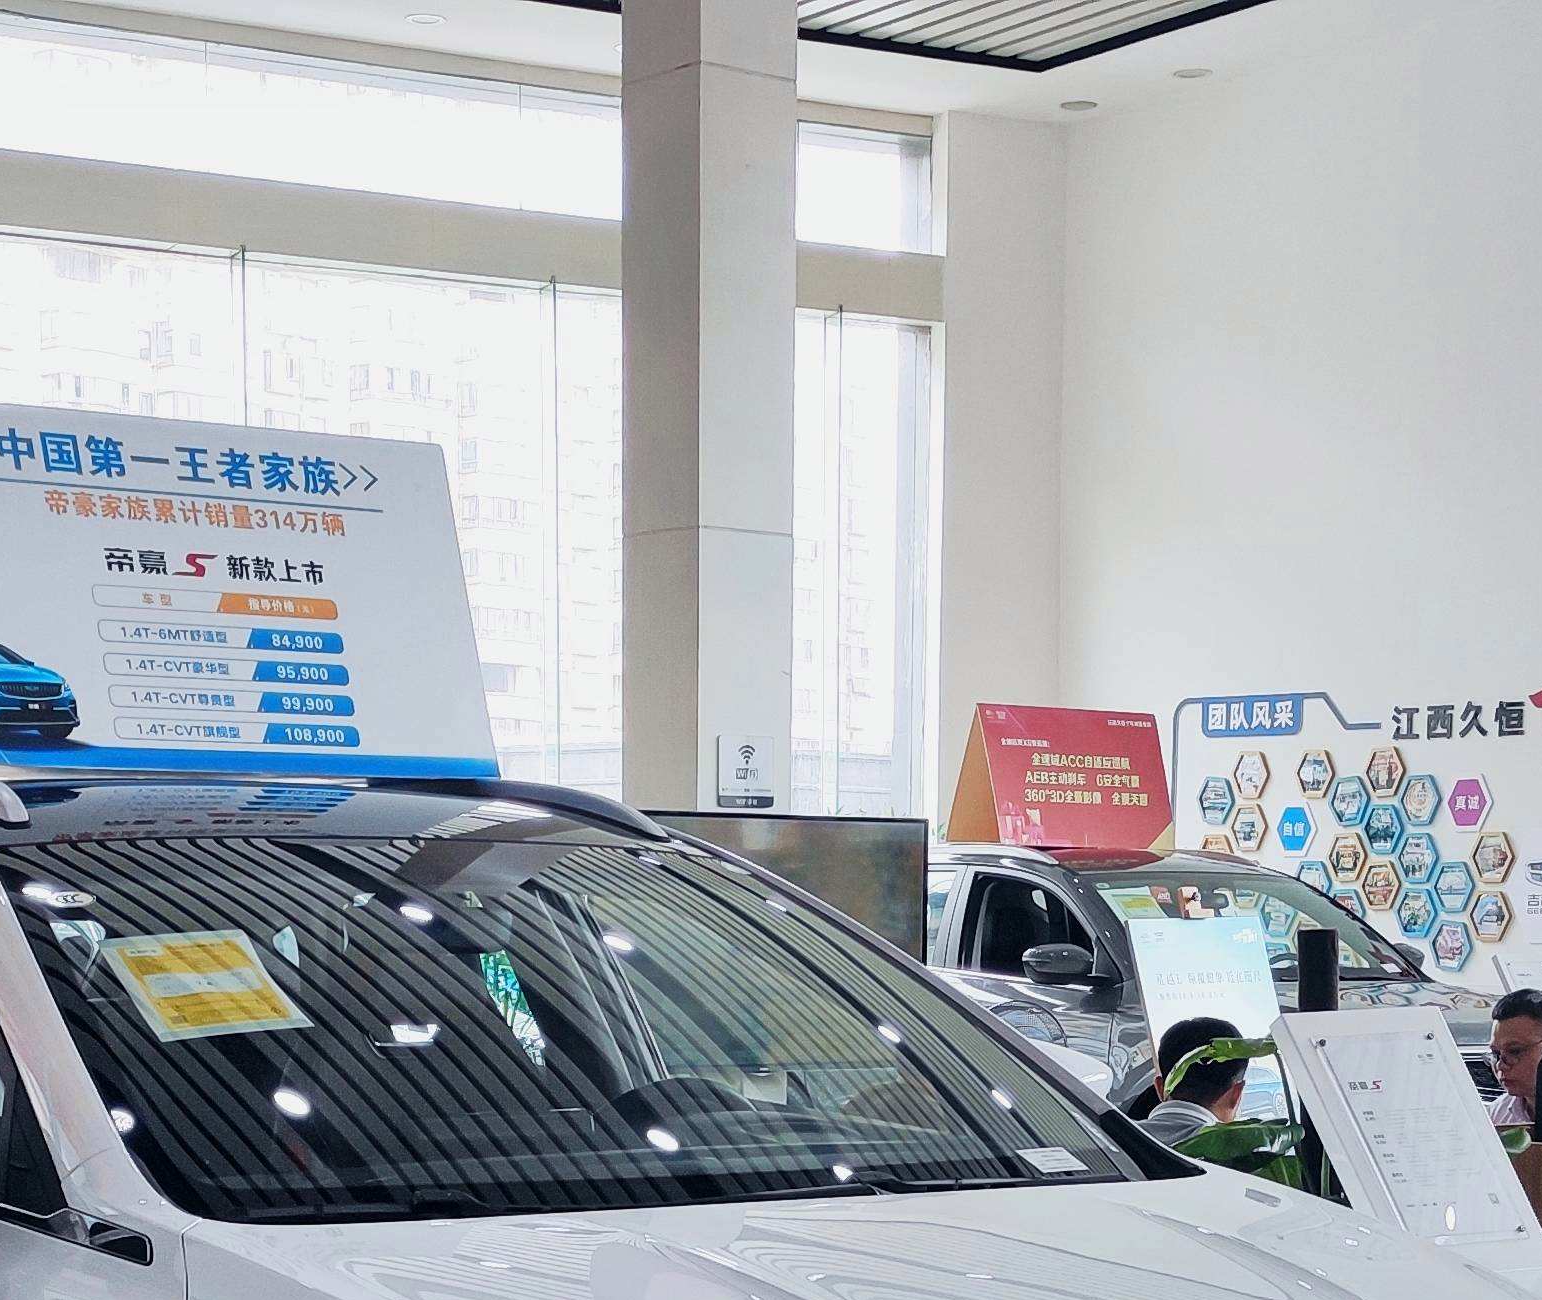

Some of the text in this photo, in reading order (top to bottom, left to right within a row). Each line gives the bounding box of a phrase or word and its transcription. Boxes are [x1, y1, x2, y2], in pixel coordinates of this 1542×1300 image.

[44, 490, 346, 537] 帝豪家族累计销量314万辆
[226, 553, 325, 585] 新款上市
[271, 633, 324, 650] 84,900
[276, 664, 329, 682] 95,900
[281, 696, 334, 713] 99,900
[1206, 700, 1295, 731] 团队风采
[1391, 700, 1526, 740] 江西久恒
[284, 727, 345, 744] 108,900
[1454, 793, 1481, 811] 真诚
[1282, 820, 1307, 838] 自信
